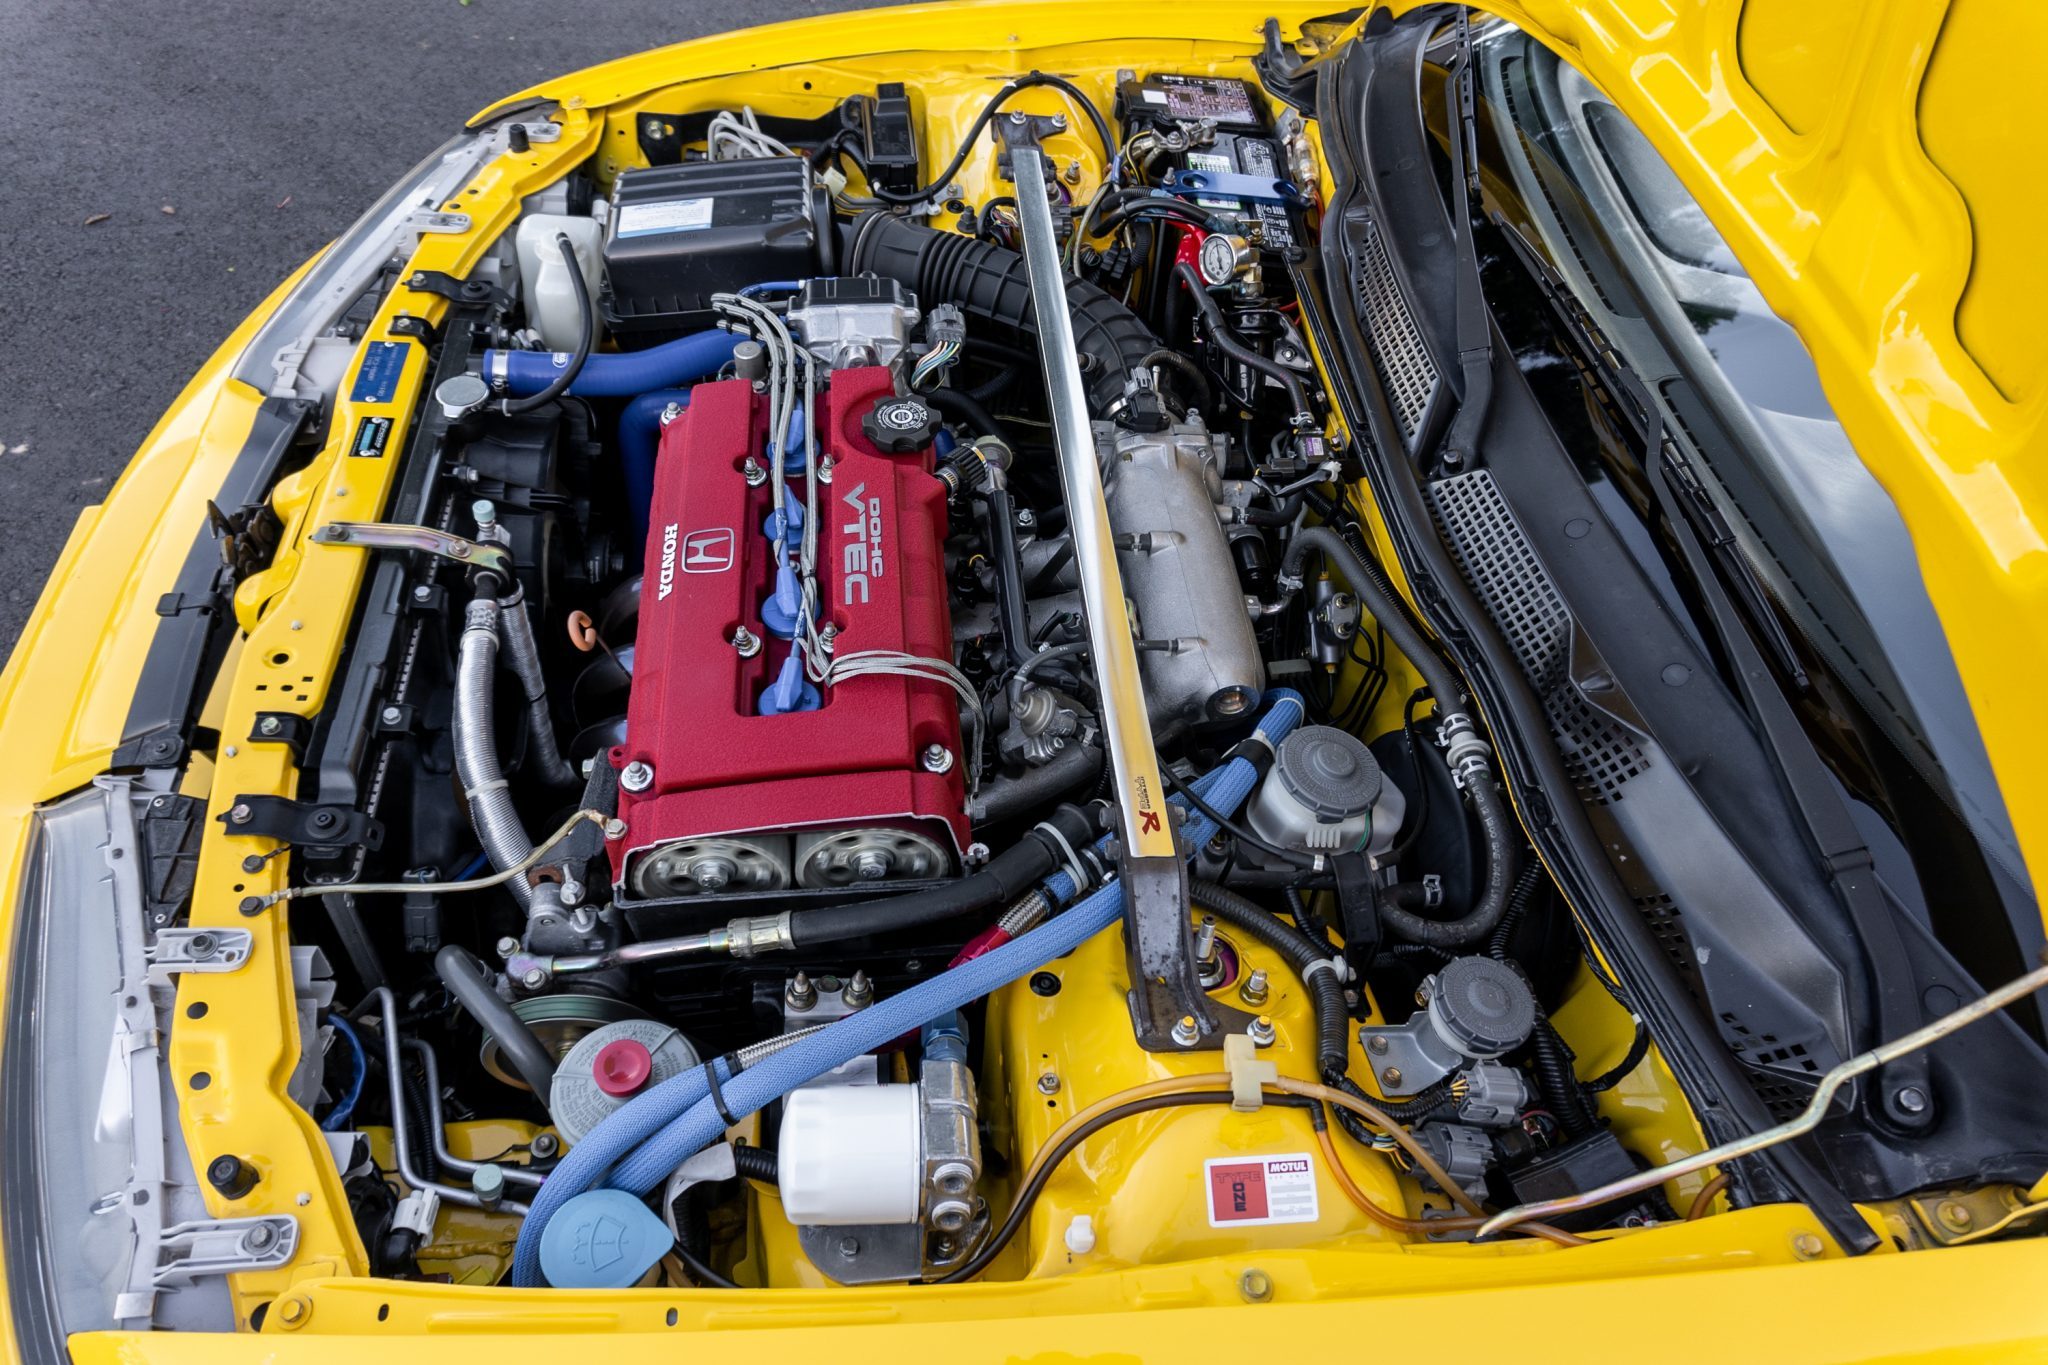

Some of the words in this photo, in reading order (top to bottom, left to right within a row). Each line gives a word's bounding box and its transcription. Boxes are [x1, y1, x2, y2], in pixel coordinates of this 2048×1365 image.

[842, 482, 869, 605] VTEC
[869, 497, 883, 578] DOHC
[658, 523, 678, 601] HONDA
[1134, 776, 1147, 809] TYPE
[1140, 776, 1151, 809] INTEGRA
[1139, 810, 1161, 835] R
[1215, 1170, 1262, 1184] TYPE
[1269, 1161, 1307, 1173] MOTUL
[1232, 1182, 1247, 1213] ONE
